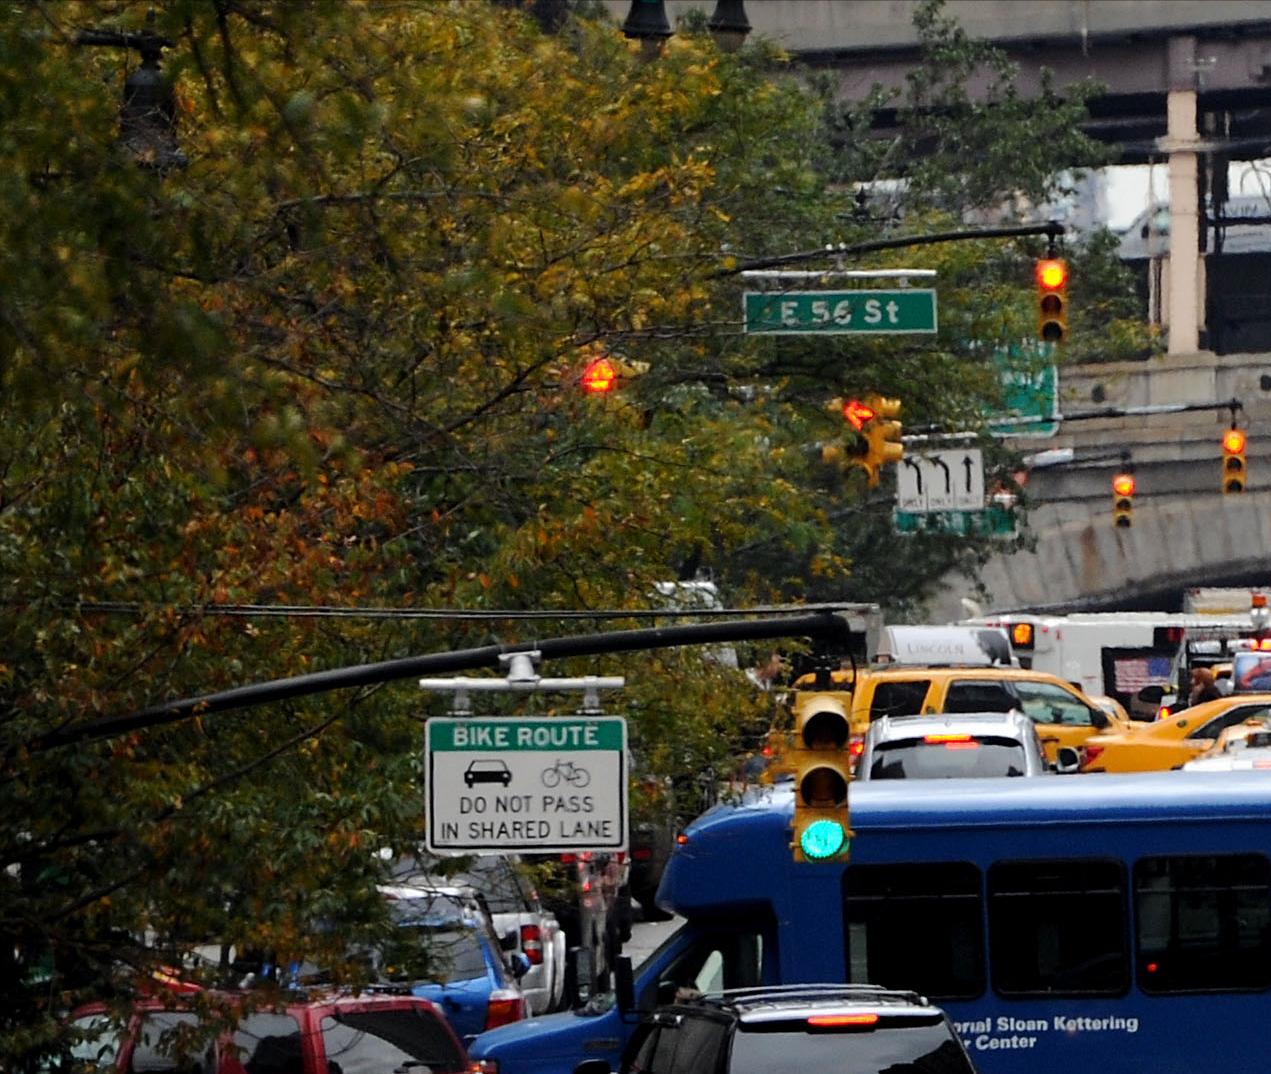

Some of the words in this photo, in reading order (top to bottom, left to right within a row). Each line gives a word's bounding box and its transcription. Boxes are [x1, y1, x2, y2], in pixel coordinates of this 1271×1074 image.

[780, 301, 799, 325] E
[811, 300, 852, 325] 56
[864, 299, 899, 323] St
[453, 726, 510, 747] BIKE
[517, 726, 599, 747] ROUTE
[460, 797, 487, 814] DO
[496, 796, 533, 814] NOT
[542, 796, 595, 814] PASS
[441, 822, 459, 839] IN
[468, 820, 551, 839] SHARED
[560, 820, 612, 839] LANE
[996, 1016, 1049, 1032] Sloan
[1053, 1015, 1139, 1033] Kettering
[975, 1034, 1037, 1051] Center
